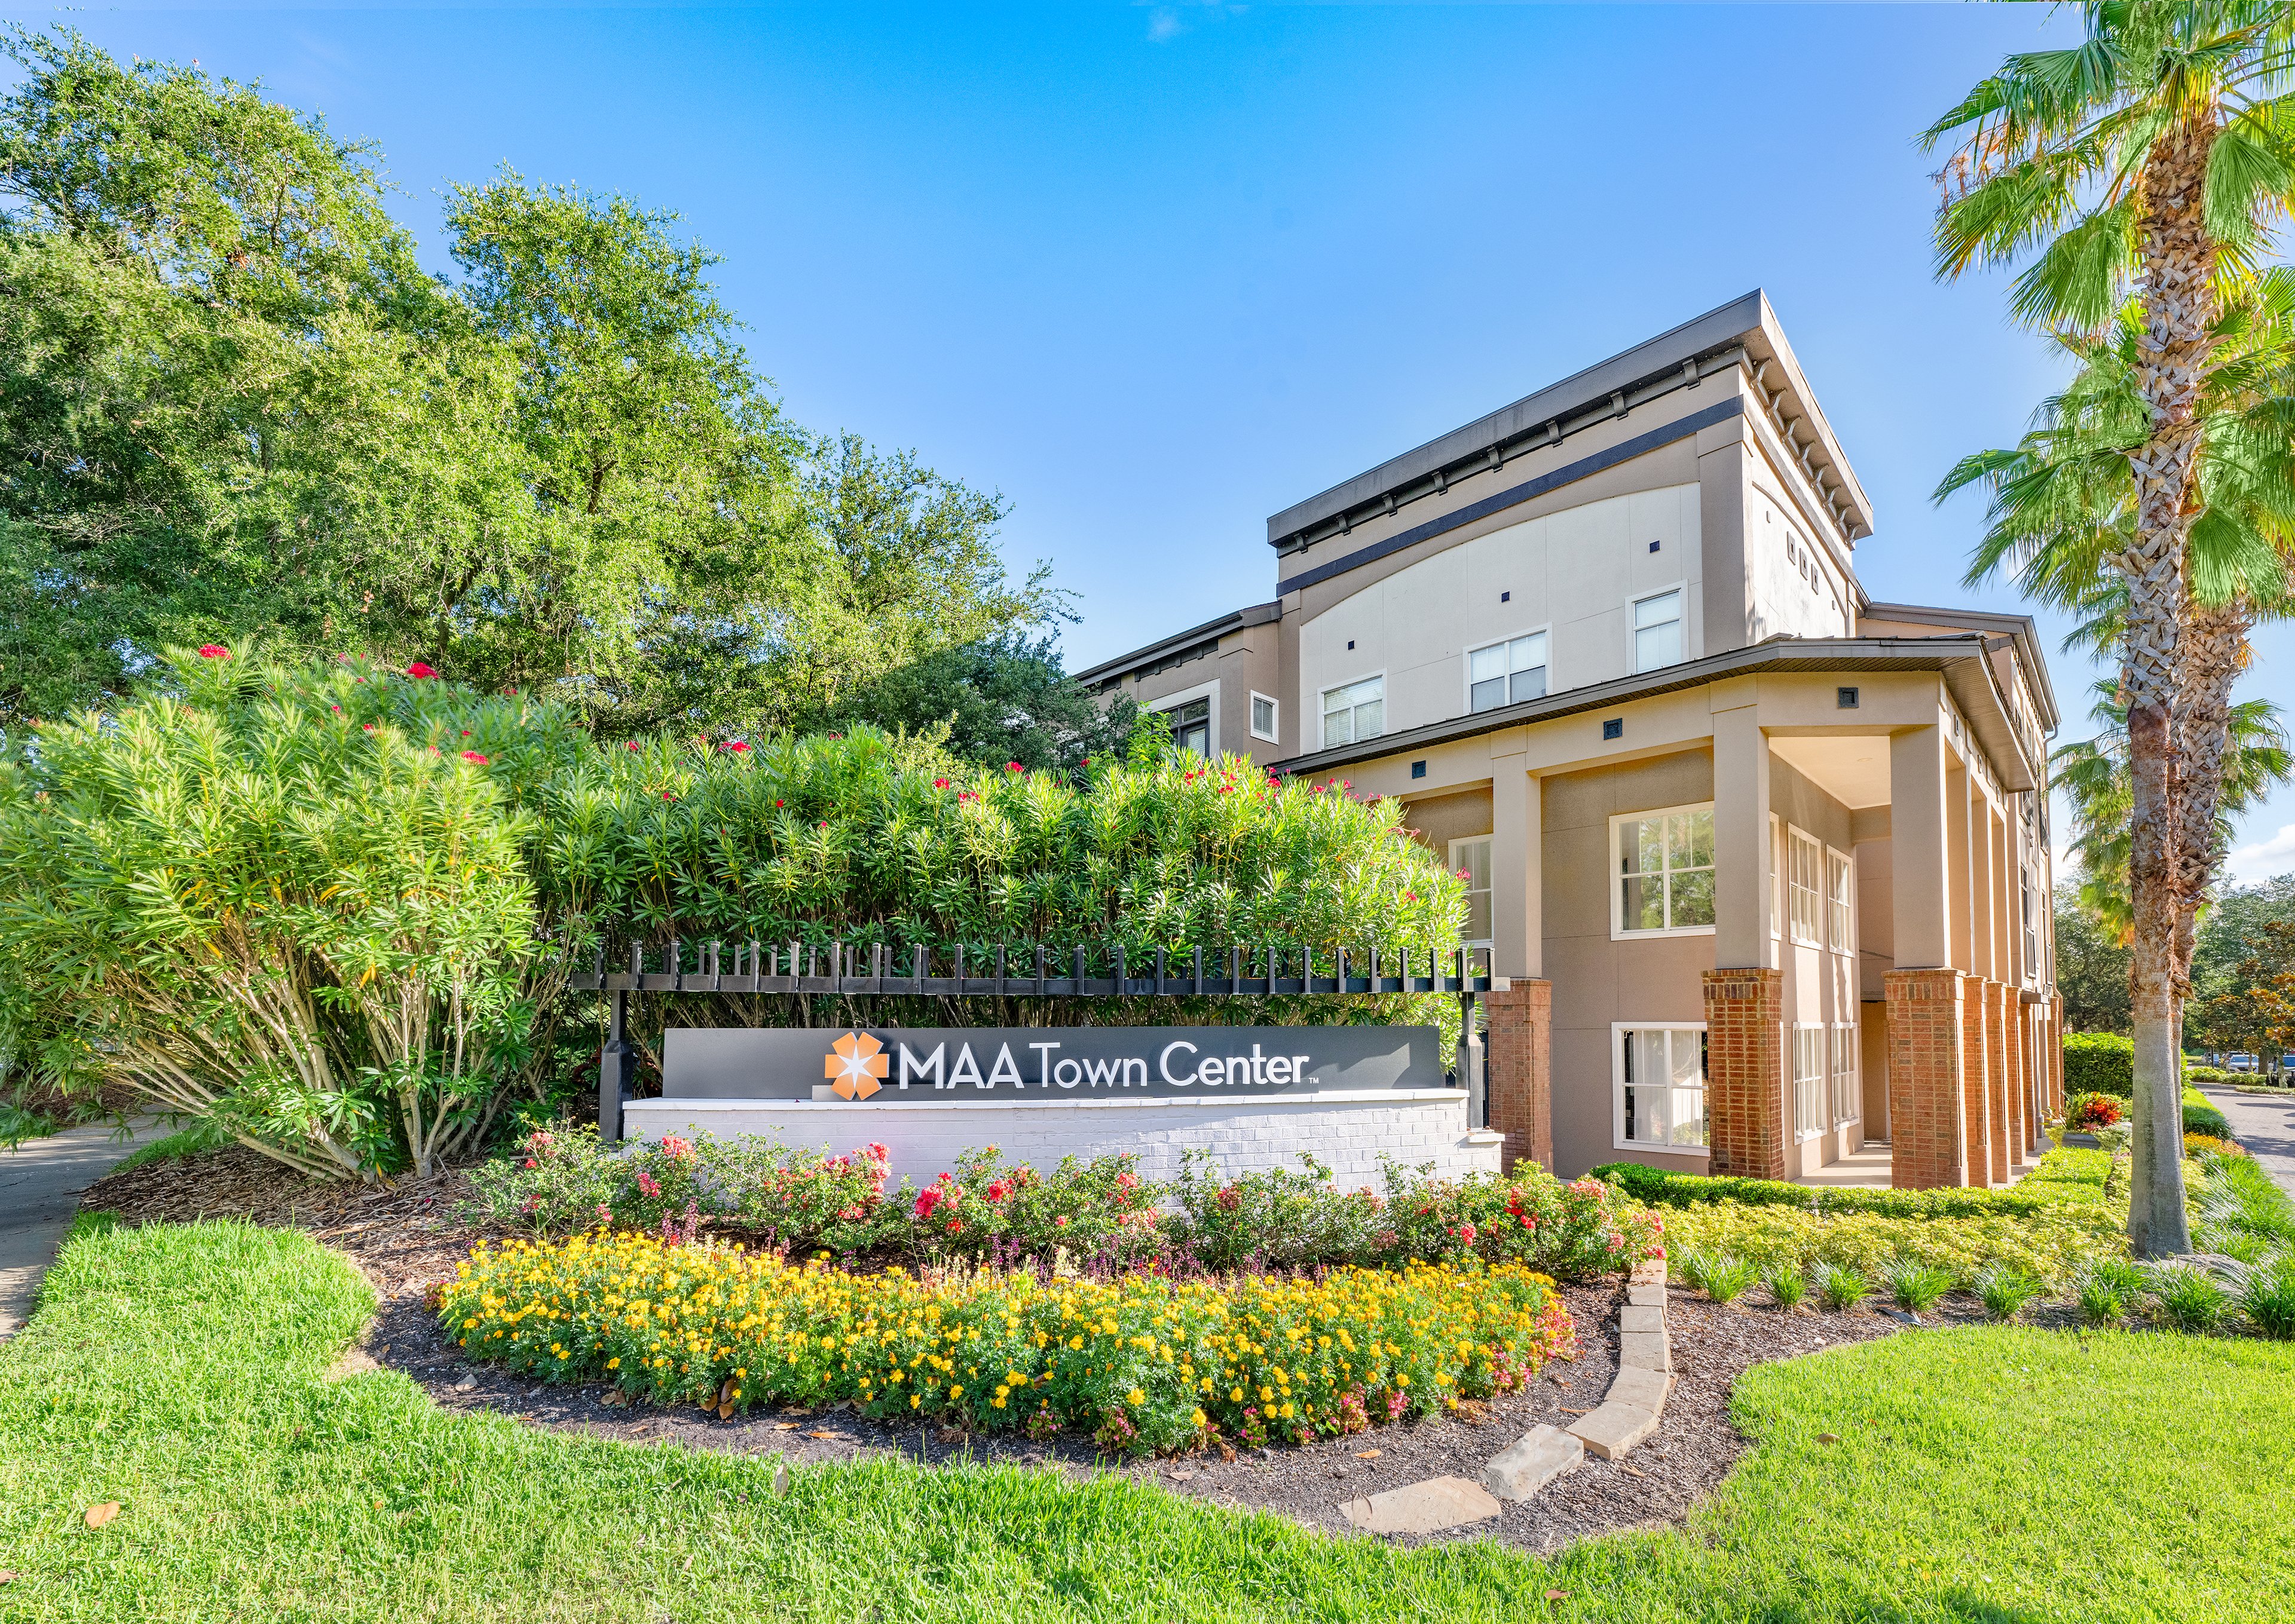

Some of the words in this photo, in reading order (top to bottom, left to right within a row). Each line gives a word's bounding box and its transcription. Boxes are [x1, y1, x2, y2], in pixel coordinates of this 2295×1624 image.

[899, 1041, 1025, 1089] MAA
[1029, 1041, 1147, 1089] Town
[1159, 1041, 1310, 1086] Center
